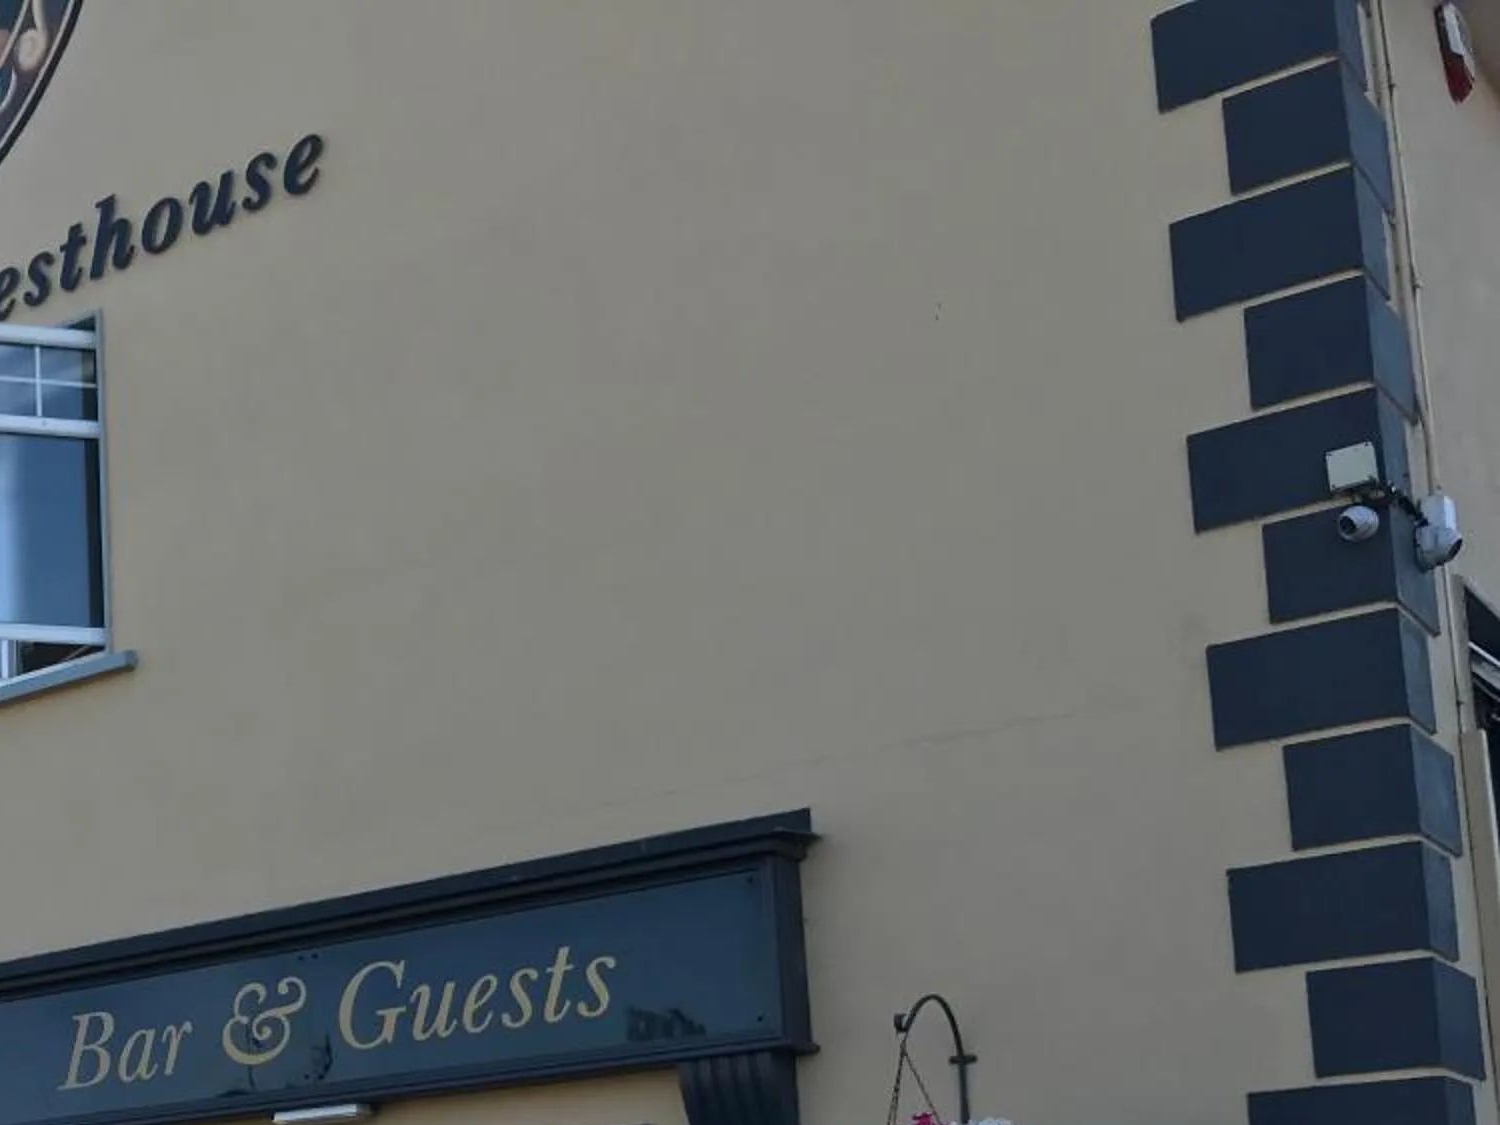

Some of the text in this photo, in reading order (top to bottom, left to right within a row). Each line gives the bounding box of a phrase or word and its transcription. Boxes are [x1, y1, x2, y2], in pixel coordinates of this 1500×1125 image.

[58, 946, 617, 1091] Bar & Guests
